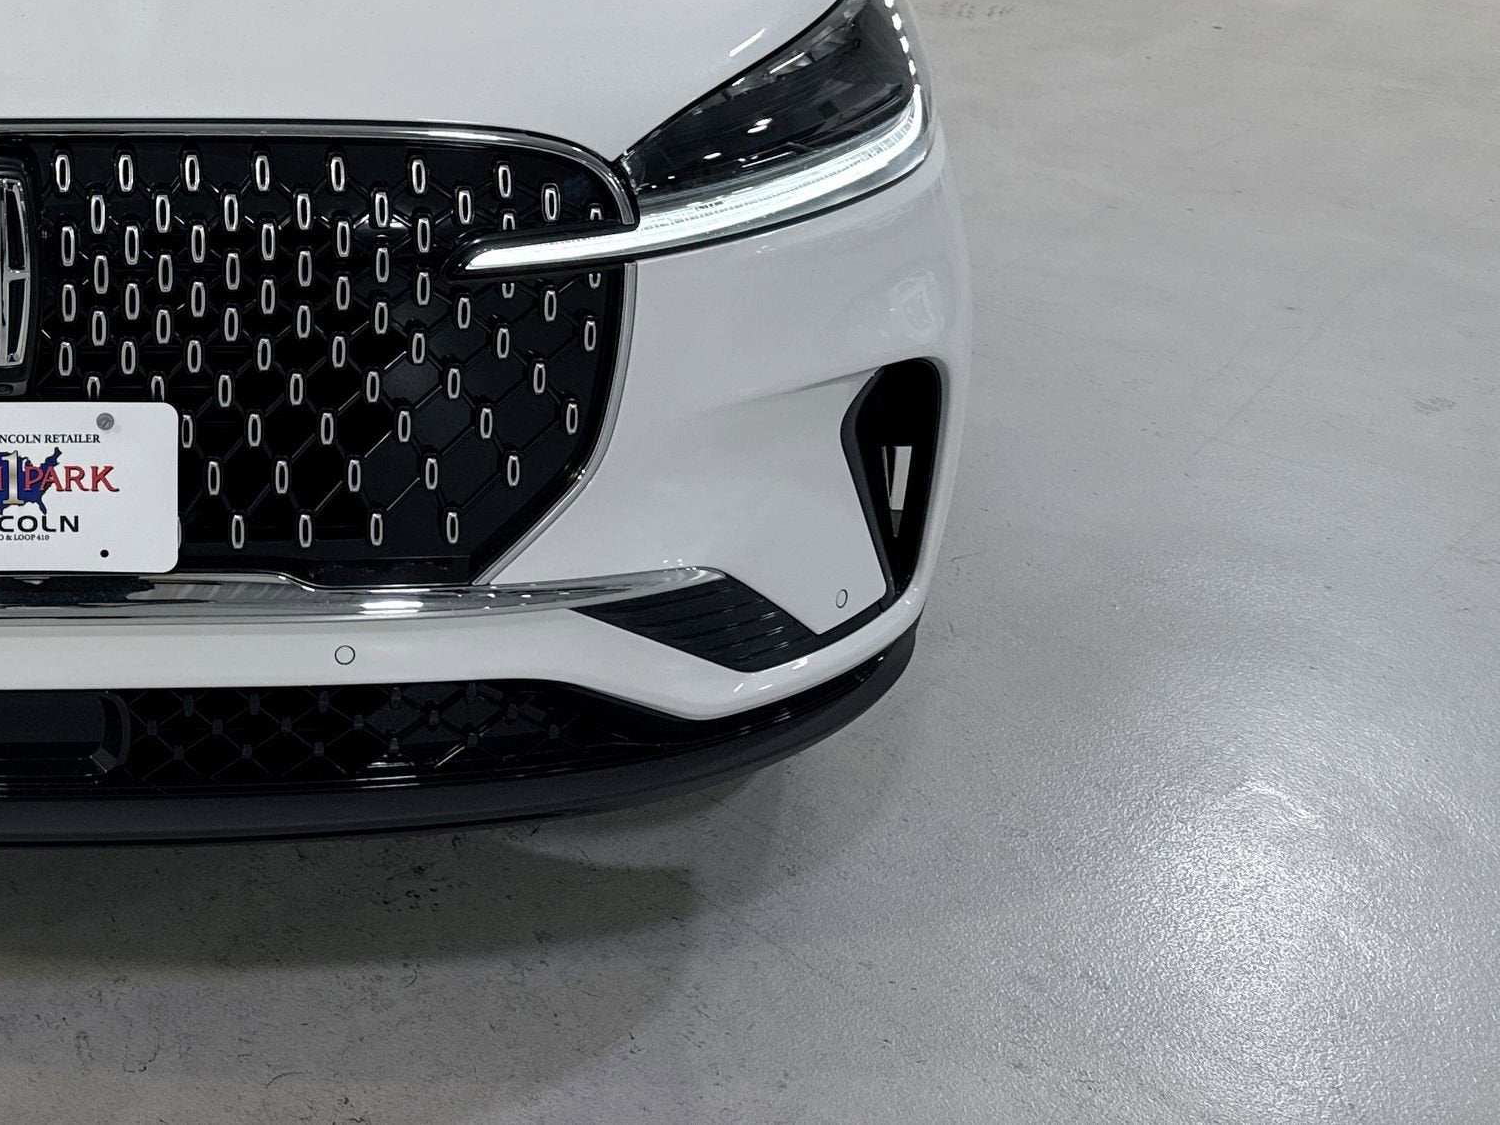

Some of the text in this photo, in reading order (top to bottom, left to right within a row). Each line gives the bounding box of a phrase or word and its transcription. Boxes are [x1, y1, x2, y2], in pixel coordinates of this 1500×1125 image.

[44, 433, 101, 444] RETAILER
[23, 465, 120, 492] PARK
[13, 533, 35, 542] LOOP
[35, 533, 50, 542] 410
